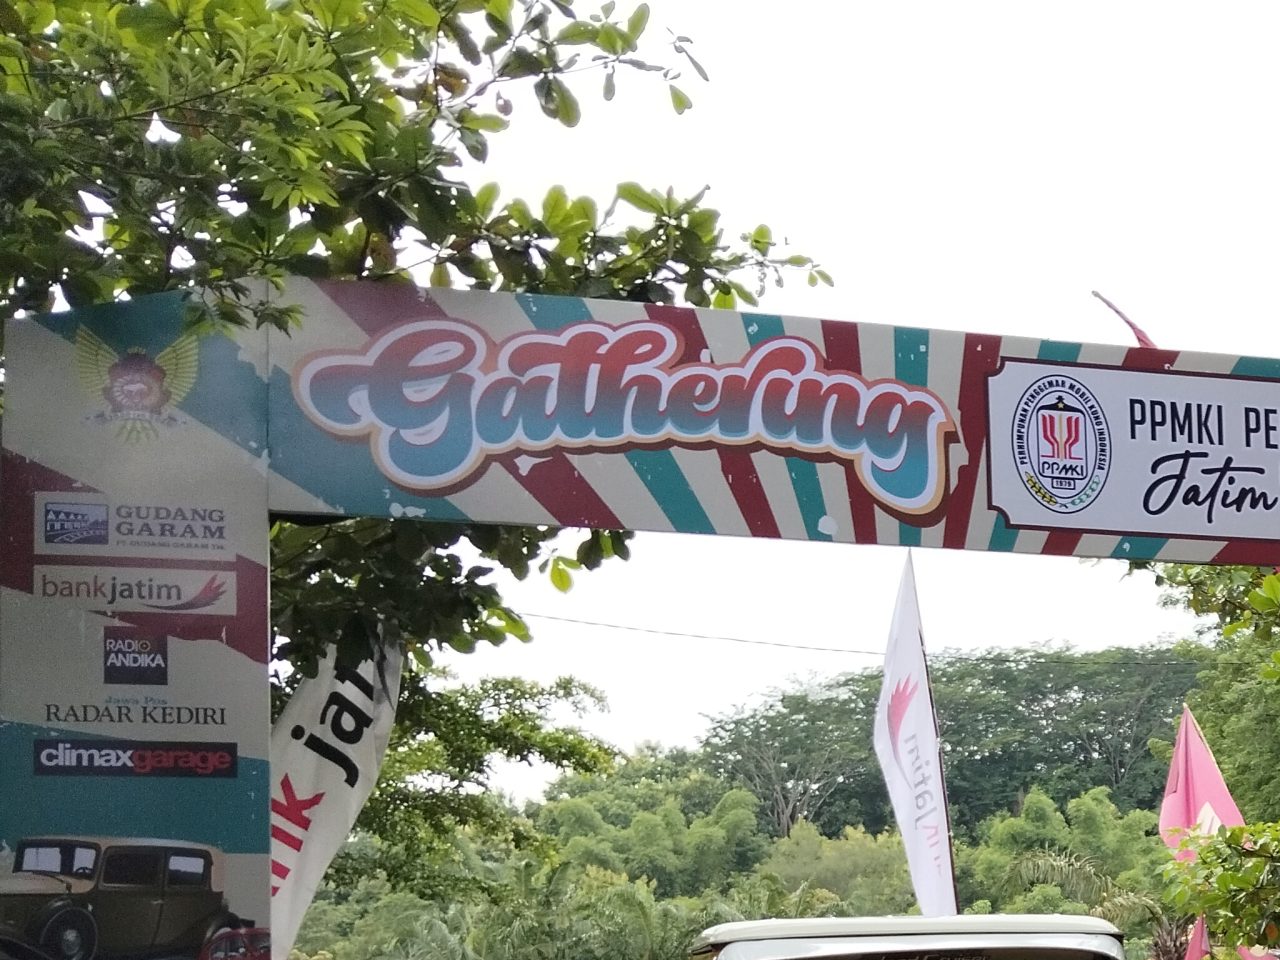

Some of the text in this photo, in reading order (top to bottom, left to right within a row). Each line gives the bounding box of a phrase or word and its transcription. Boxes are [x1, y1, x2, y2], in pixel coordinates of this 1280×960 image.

[298, 318, 954, 514] Gathering
[1016, 380, 1108, 470] PERHIMPUNAN PENGGEMAR MOBIL KUNO INDONESIA
[1129, 398, 1224, 446] PPMKI
[1041, 461, 1084, 476] PPMKI
[1142, 449, 1279, 524] Jatim
[115, 505, 225, 523] GUDANG
[115, 521, 226, 540] GARAM
[106, 639, 151, 653] RADIO
[106, 653, 166, 668] ANDIKA
[45, 703, 227, 725] RADAR KEDIRI
